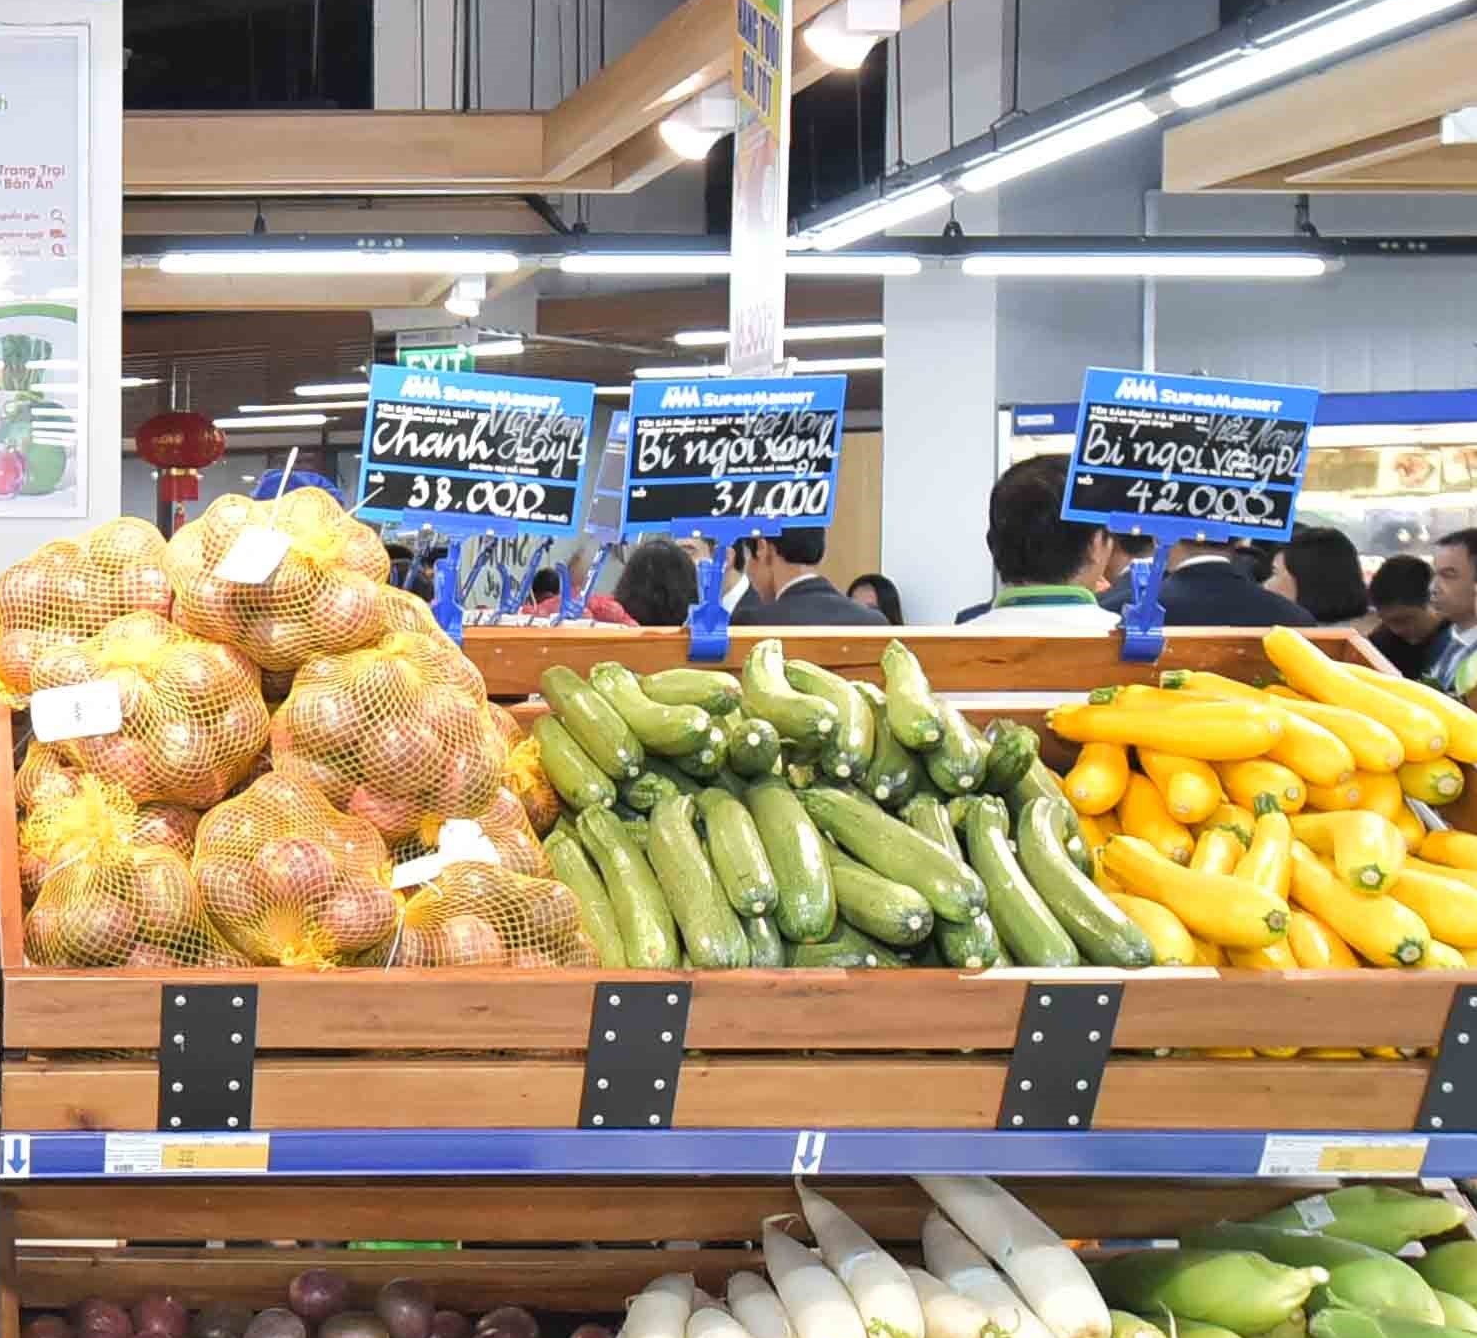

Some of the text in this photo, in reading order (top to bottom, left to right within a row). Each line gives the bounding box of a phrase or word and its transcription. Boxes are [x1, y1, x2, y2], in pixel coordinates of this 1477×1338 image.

[406, 353, 466, 372] EXIT
[372, 417, 493, 462] Chanh
[764, 423, 838, 461] xanh
[408, 475, 546, 514] 38.000
[712, 481, 830, 519] 31.000
[1127, 480, 1275, 518] 42.000
